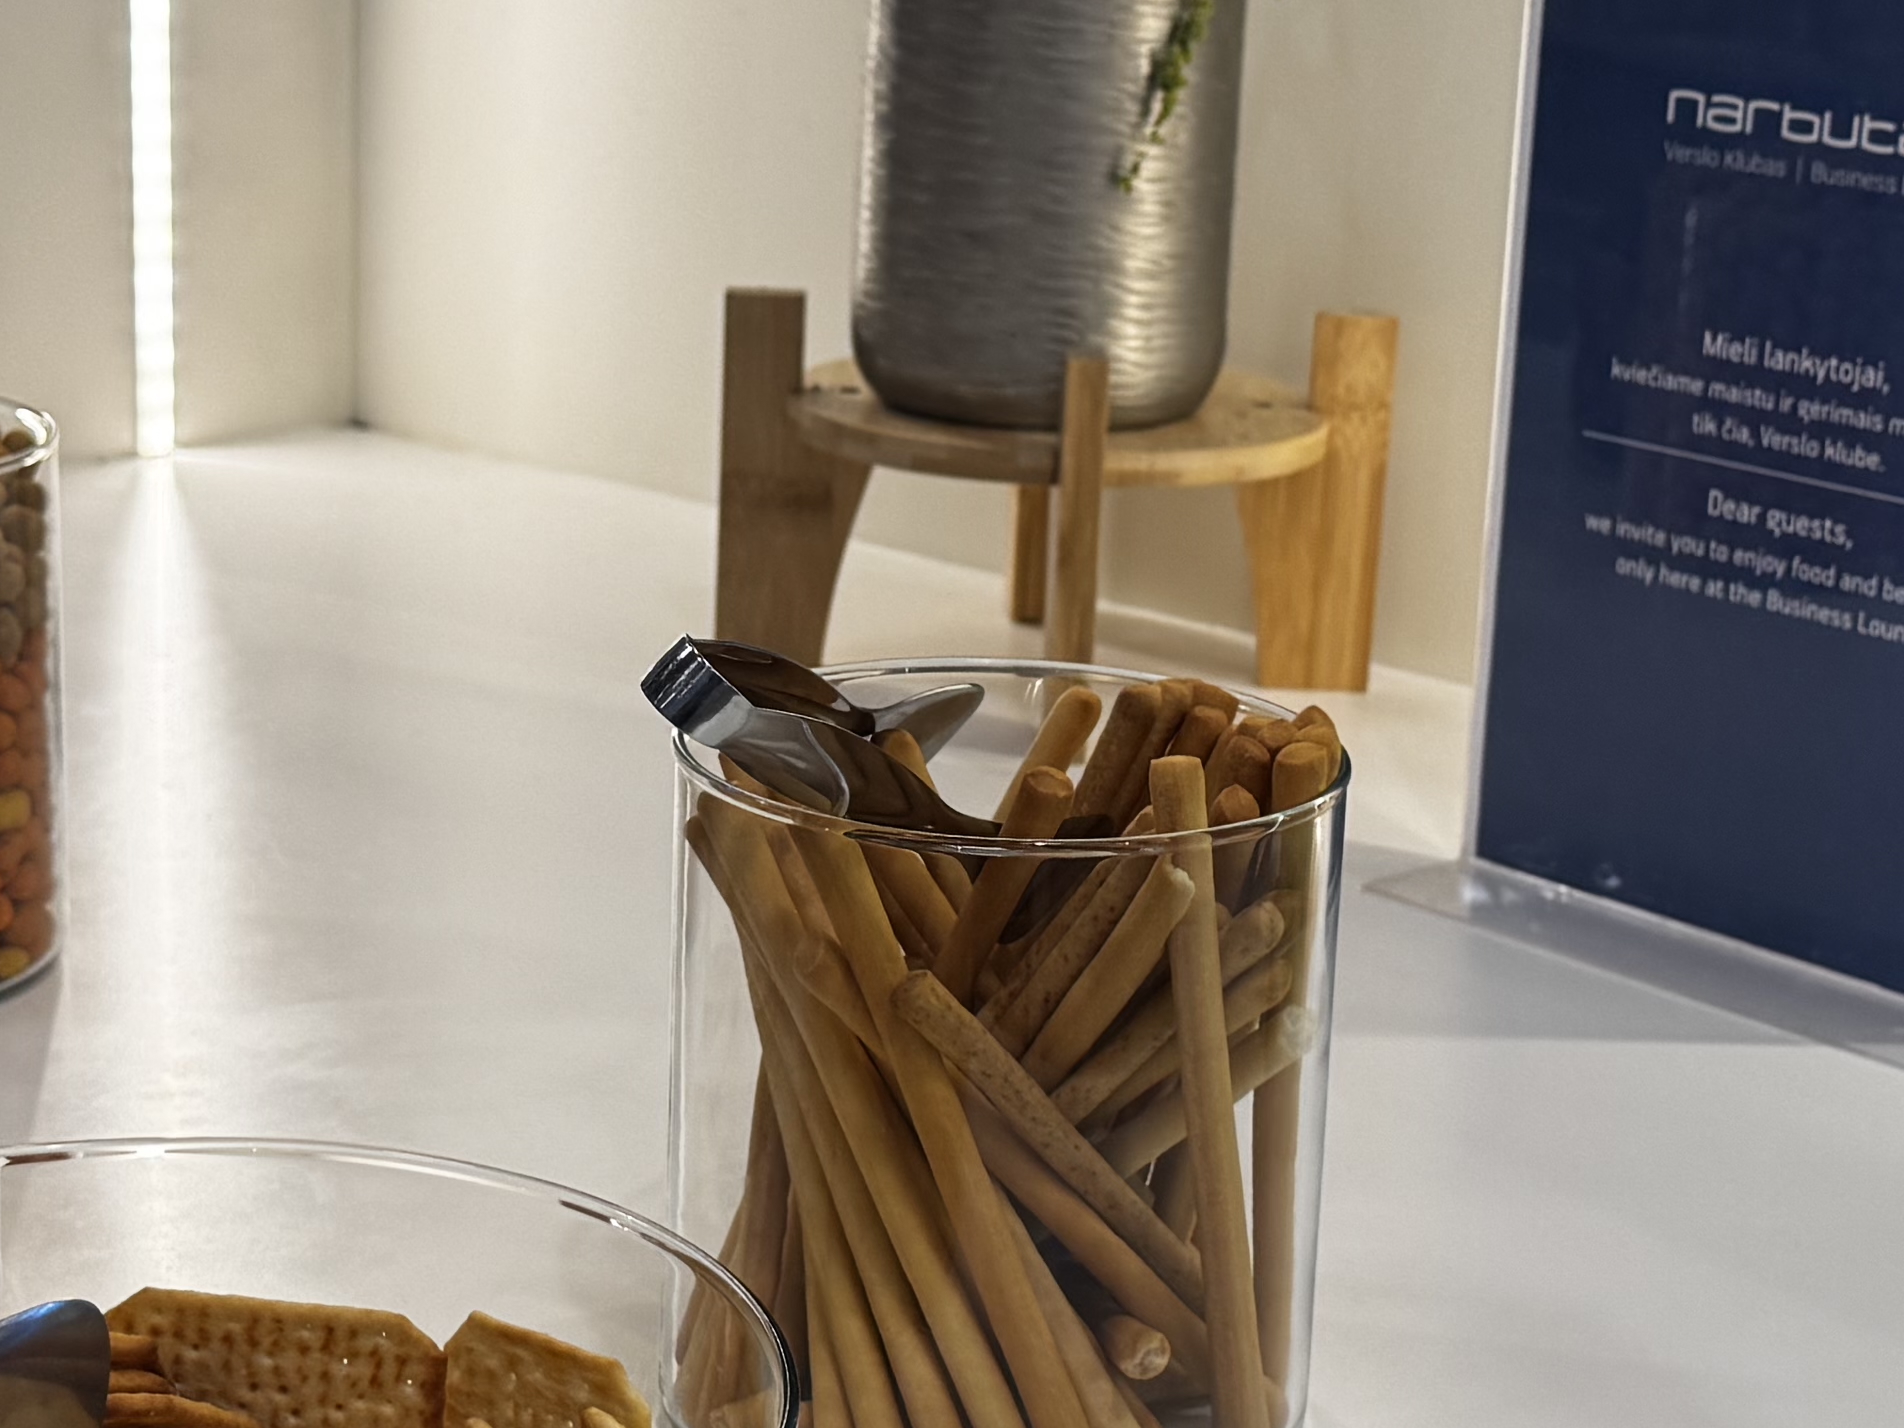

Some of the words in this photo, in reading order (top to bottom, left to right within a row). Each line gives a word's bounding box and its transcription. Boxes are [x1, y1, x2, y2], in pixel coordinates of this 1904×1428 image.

[1664, 140, 1719, 170] Verslo
[1723, 148, 1788, 179] Klubas
[1810, 160, 1899, 195] Business
[1611, 356, 1704, 397] kviečiame
[1707, 377, 1776, 412] maistu
[1779, 391, 1795, 414] ir
[1797, 396, 1884, 434] gėrimais
[1702, 329, 1757, 362] Mieli
[1762, 341, 1892, 396] lankytojai,
[1692, 413, 1718, 437] tik
[1759, 425, 1820, 459] Verslo
[1823, 436, 1887, 473] klube.
[1707, 487, 1761, 526] Dear
[1765, 504, 1854, 552] guests,
[1584, 513, 1612, 535] we
[1615, 515, 1667, 548] invite
[1670, 532, 1706, 557] you
[1709, 538, 1728, 563] to
[1732, 546, 1787, 580] enjoy
[1791, 554, 1837, 588] food
[1839, 571, 1878, 599] and
[1615, 555, 1656, 587] only
[1659, 562, 1702, 593] here
[1704, 576, 1725, 600] at
[1728, 579, 1762, 609] the
[1765, 587, 1853, 631] Business
